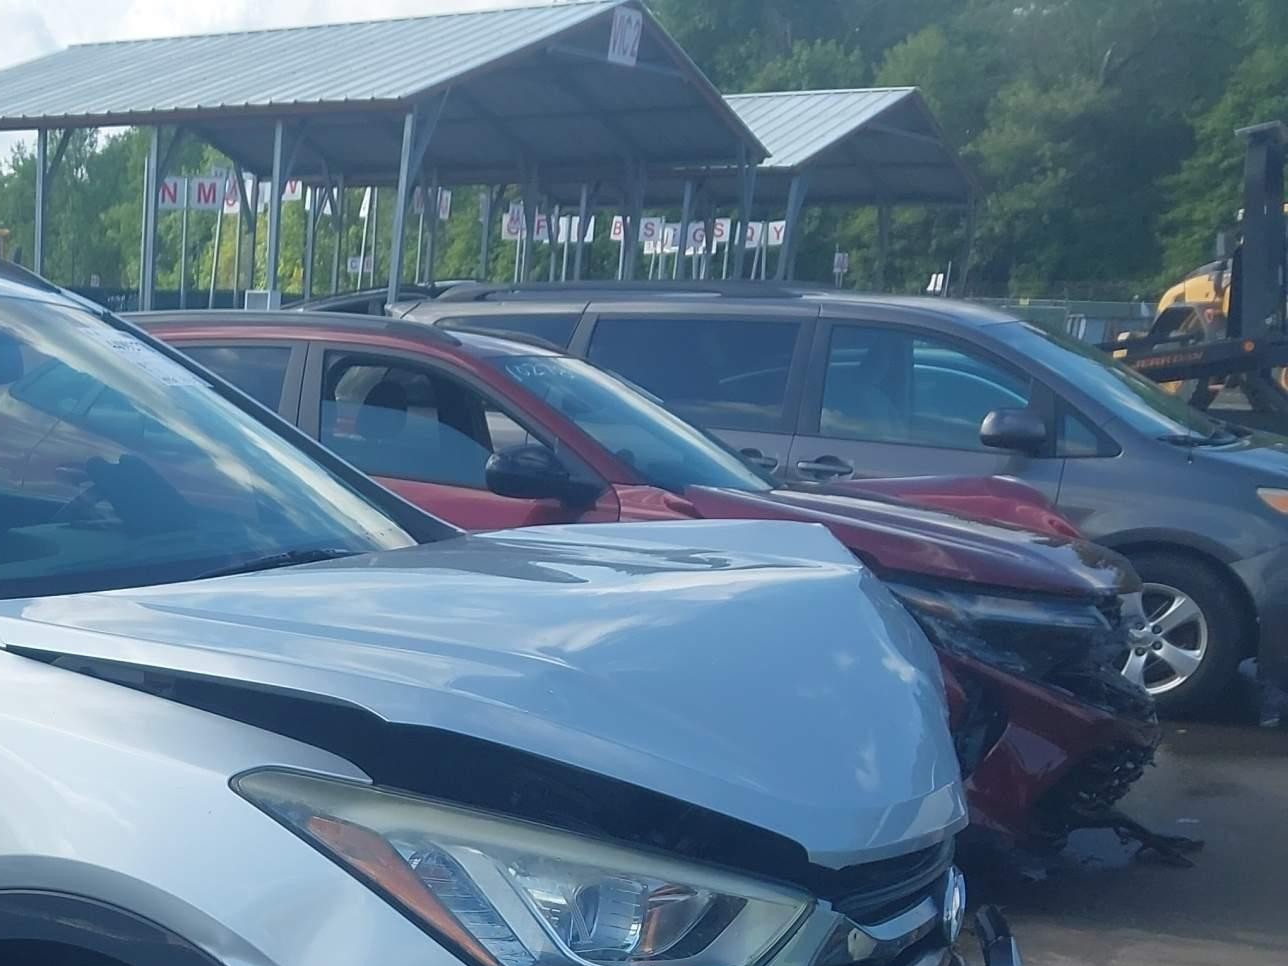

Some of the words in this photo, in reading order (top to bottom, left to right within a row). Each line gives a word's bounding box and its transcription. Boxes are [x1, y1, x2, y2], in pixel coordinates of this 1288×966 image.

[160, 181, 177, 204] N
[197, 181, 217, 204] M
[536, 218, 547, 236] F
[643, 221, 656, 238] S
[714, 223, 724, 238] S
[773, 226, 785, 241] Y
